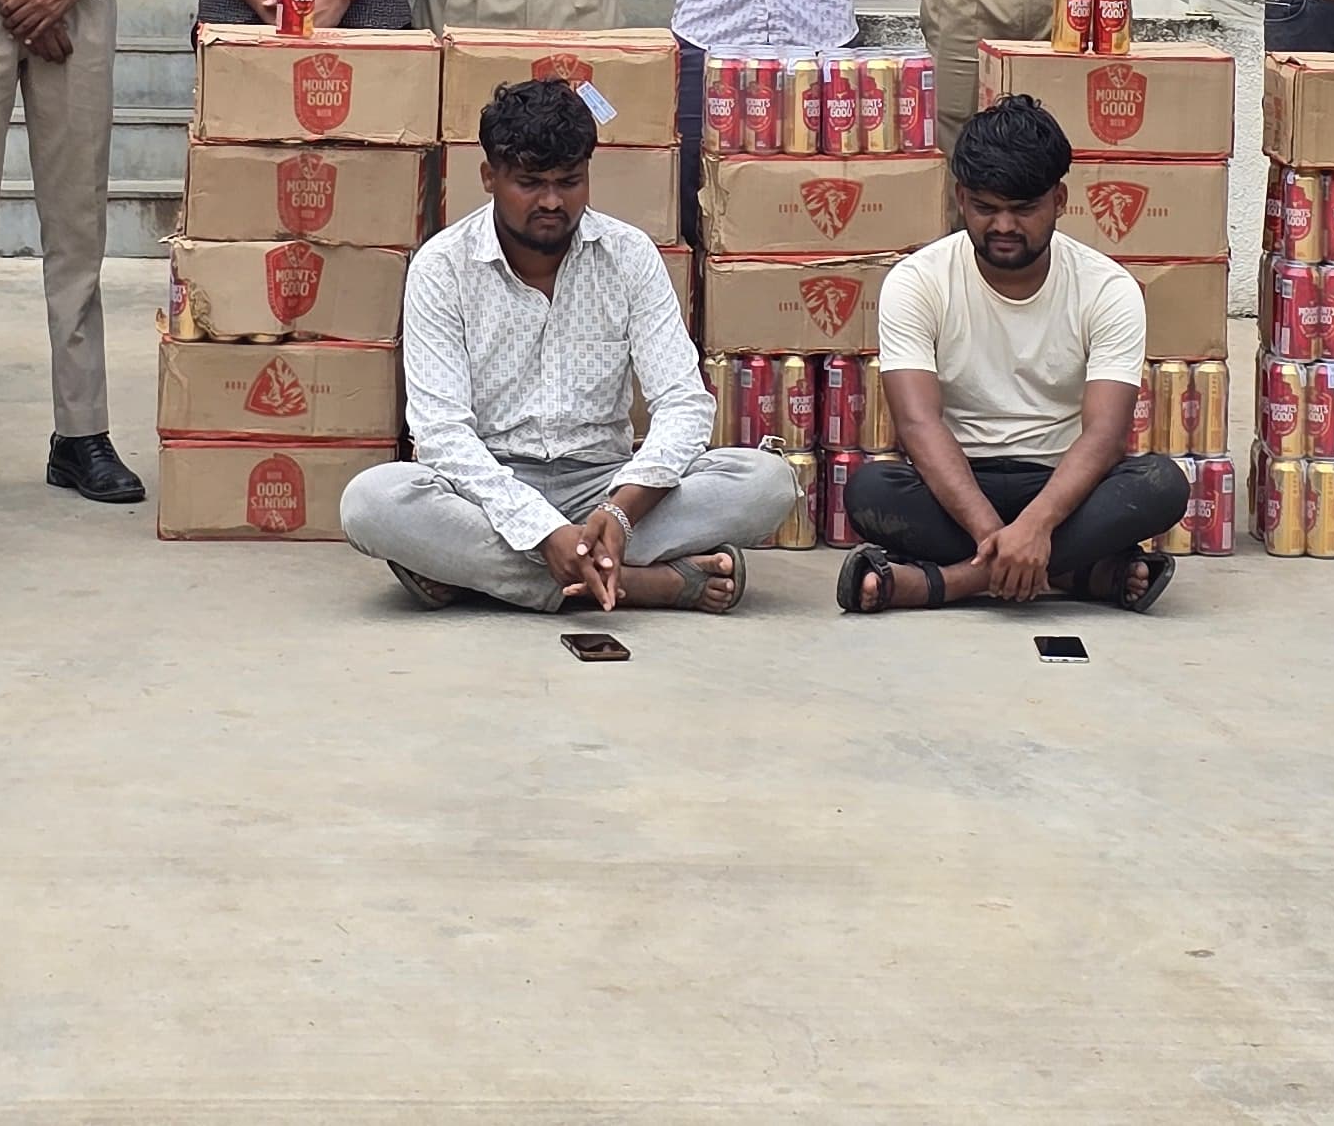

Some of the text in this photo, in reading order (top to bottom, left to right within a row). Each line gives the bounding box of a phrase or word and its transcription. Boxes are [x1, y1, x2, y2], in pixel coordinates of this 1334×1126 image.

[302, 79, 349, 92] MOUNTS
[307, 91, 343, 106] 6000
[1095, 88, 1143, 103] MOUNTS
[286, 180, 332, 194] MOUNTS
[291, 193, 327, 208] 6000
[275, 269, 318, 283] MOUNTS
[256, 481, 292, 496] 6000
[250, 496, 298, 509] MOUNTS
